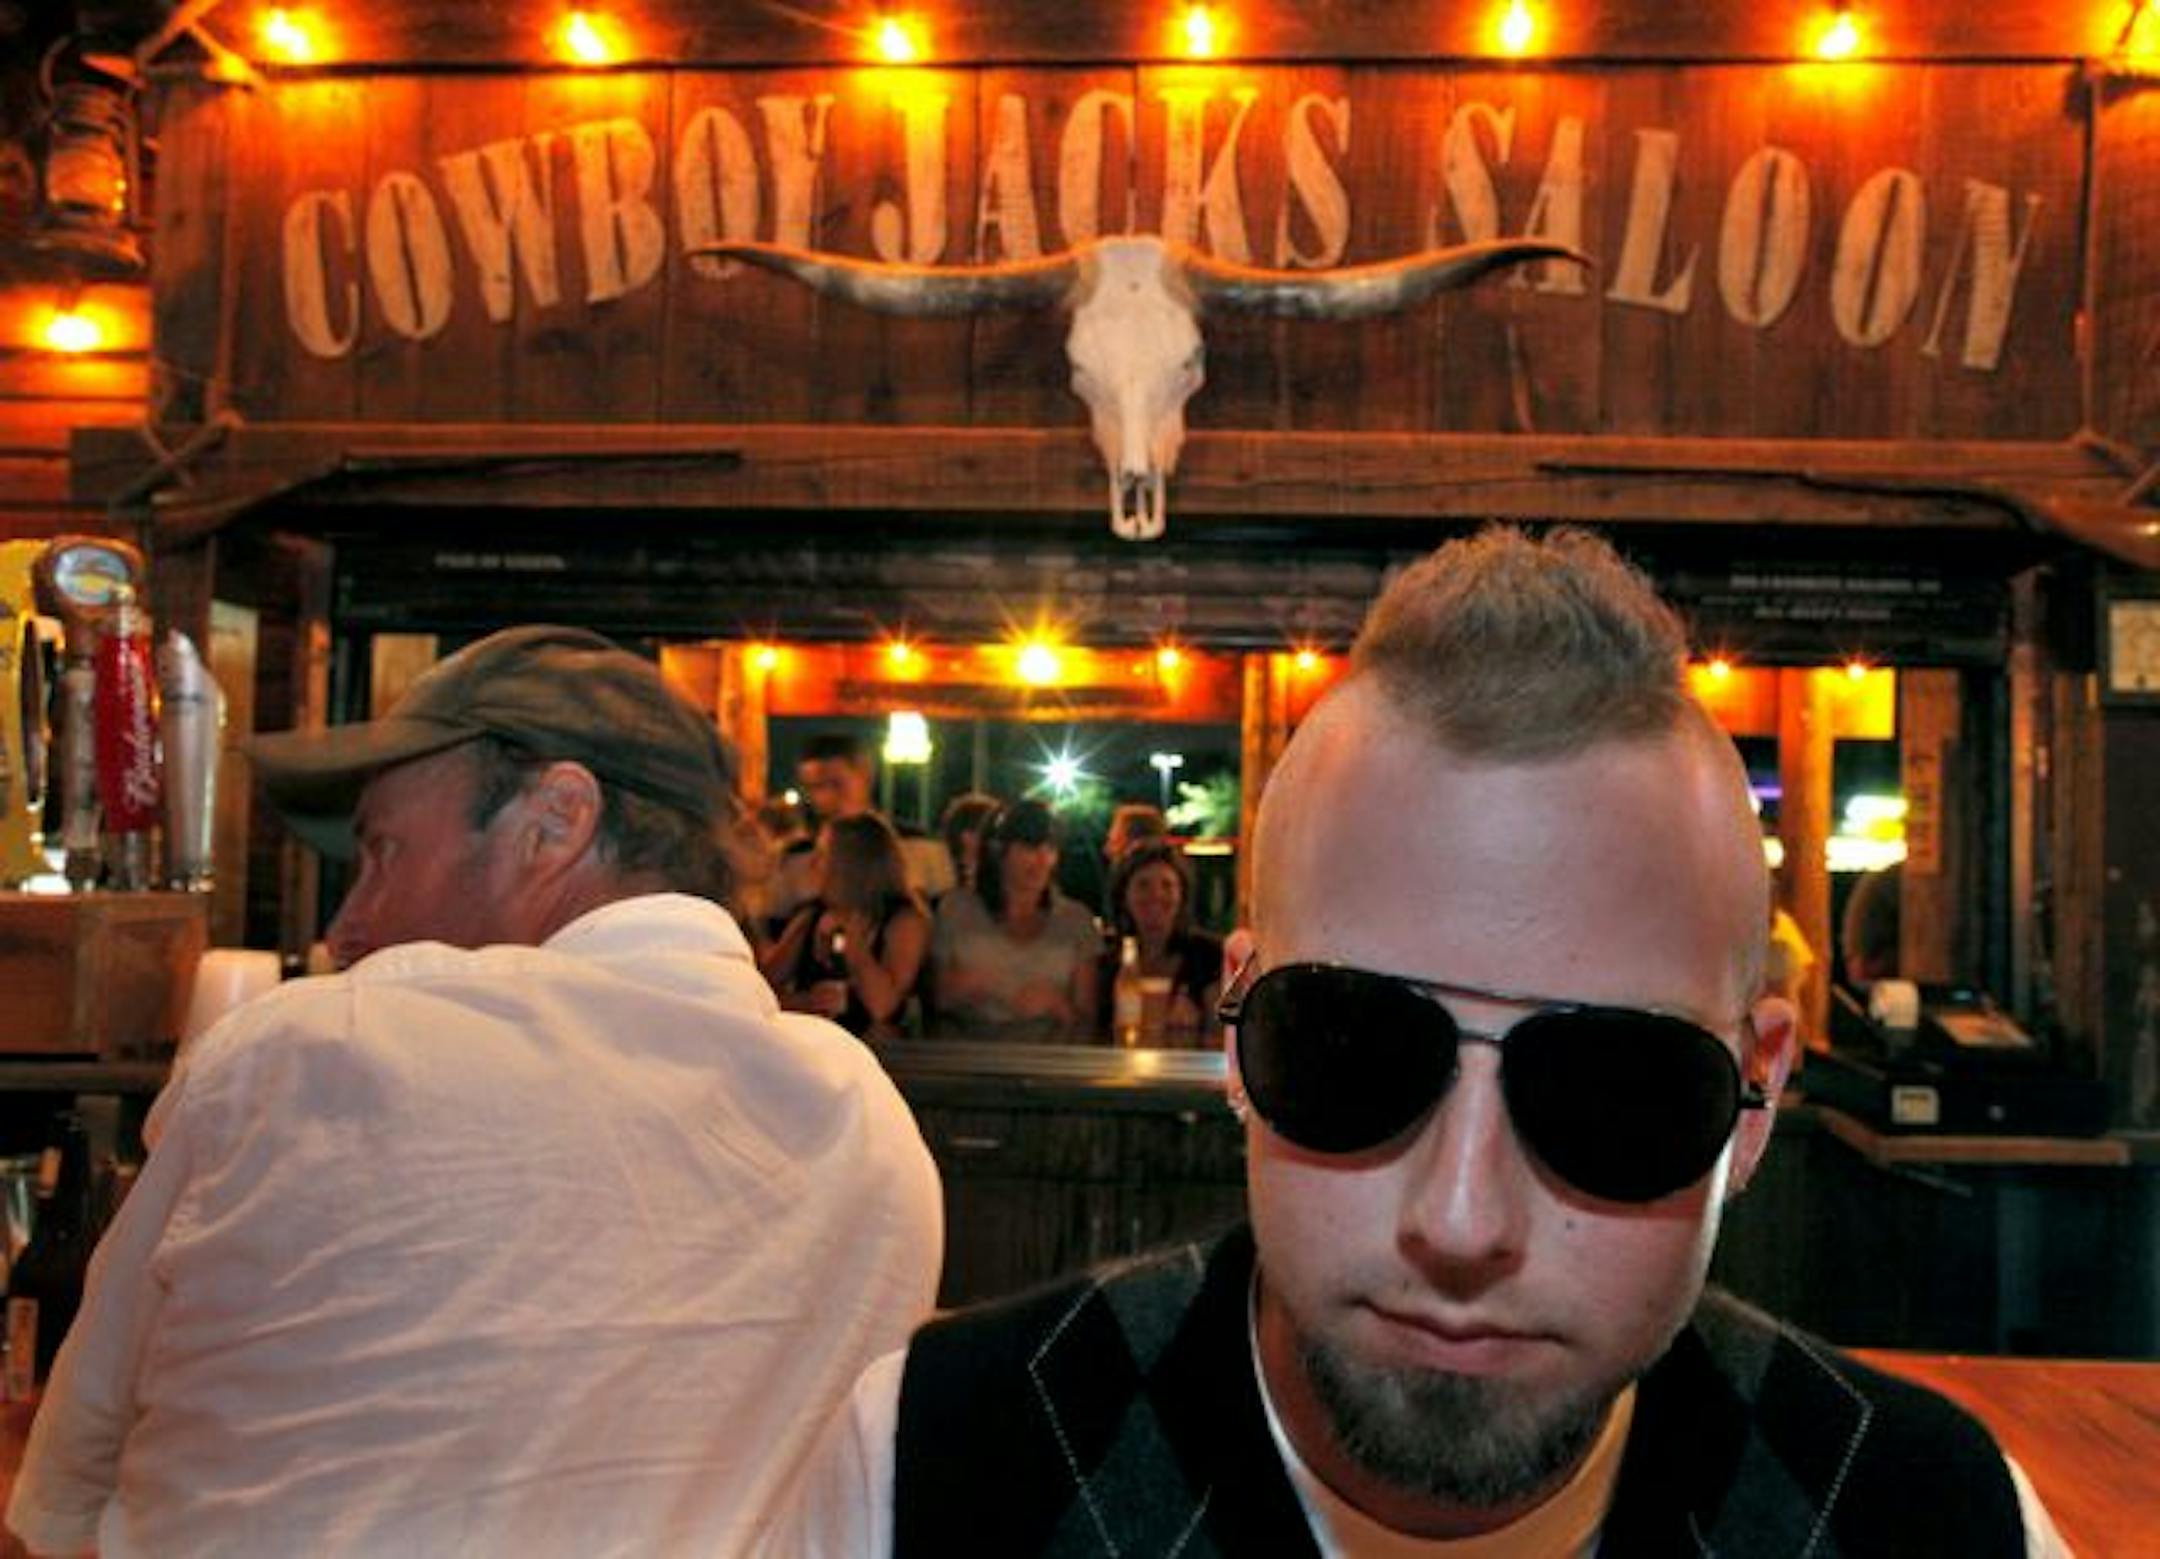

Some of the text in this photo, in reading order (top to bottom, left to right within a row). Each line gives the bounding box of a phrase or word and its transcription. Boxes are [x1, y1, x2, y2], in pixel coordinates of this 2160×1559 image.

[283, 88, 2045, 371] COWBOY JACKS SALOON
